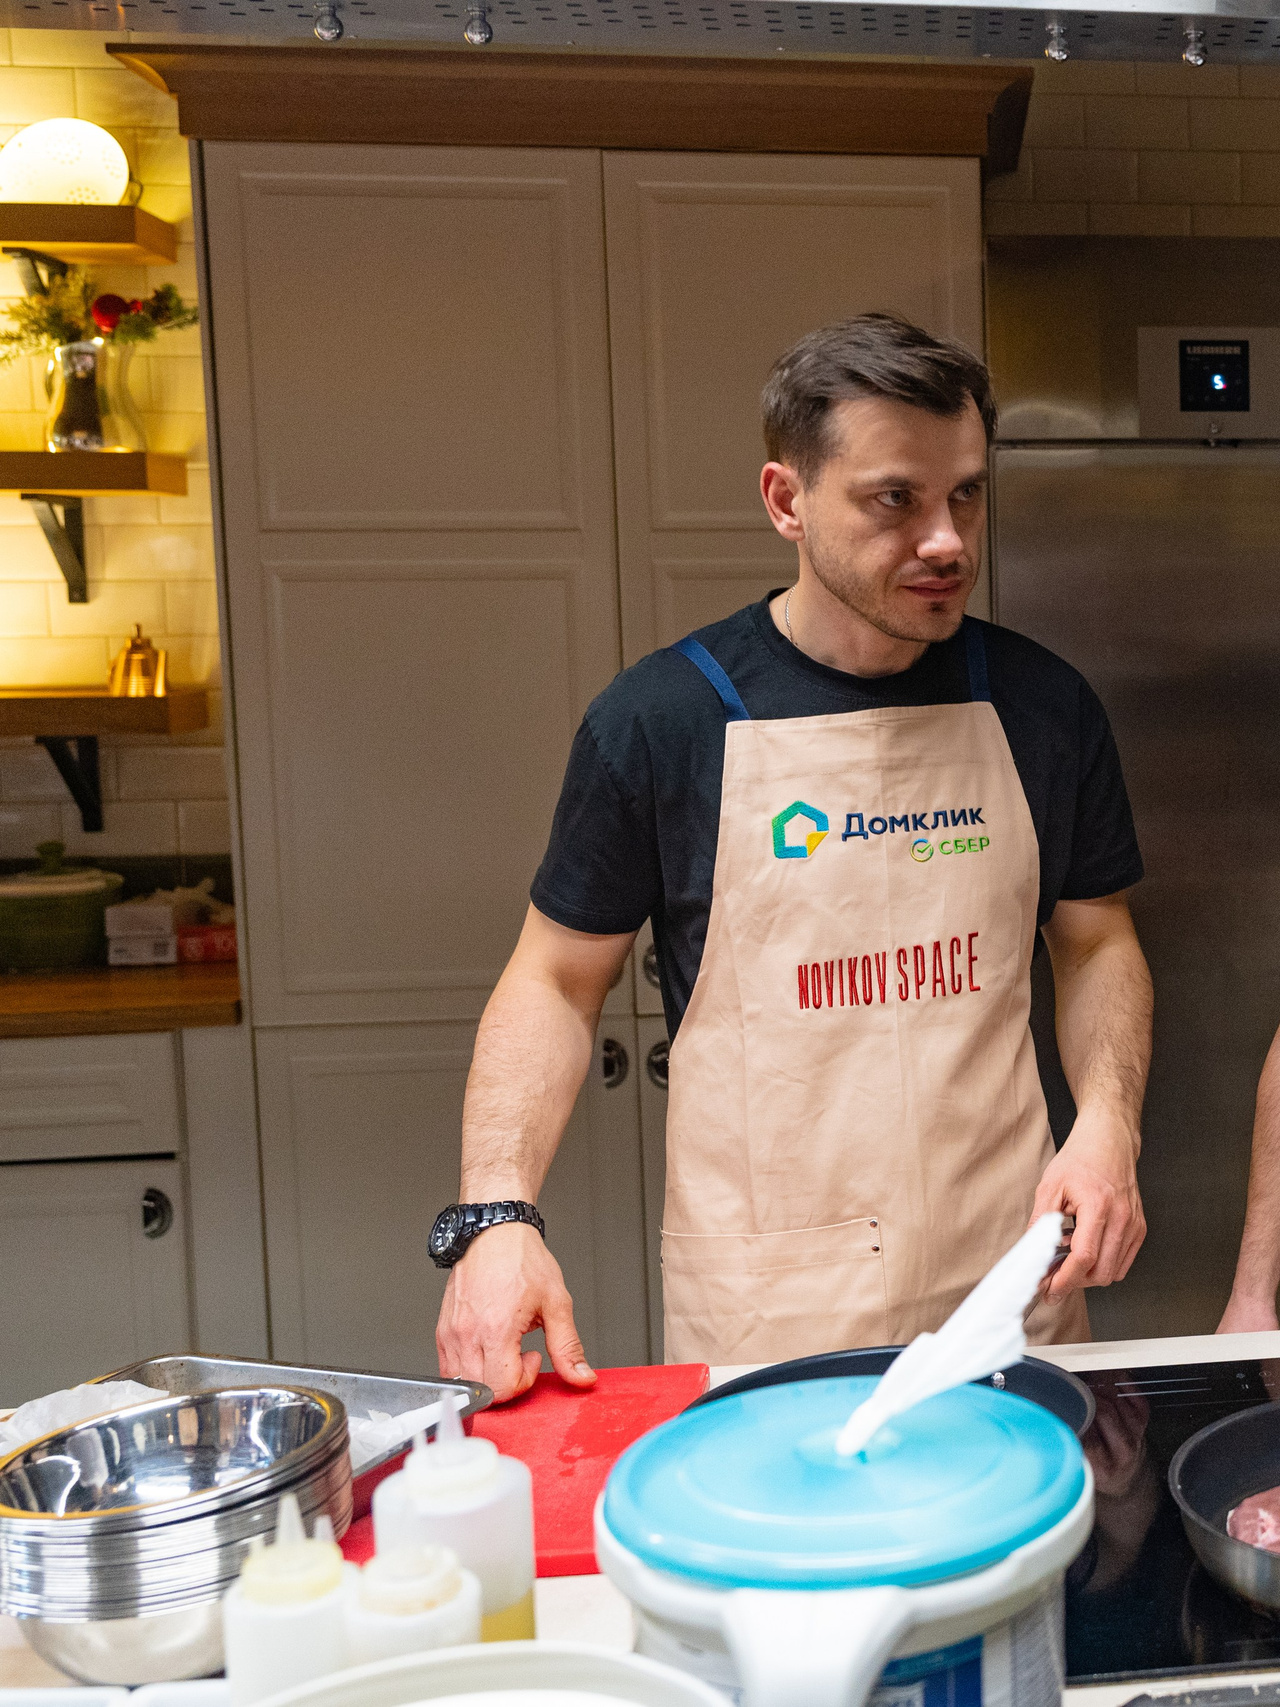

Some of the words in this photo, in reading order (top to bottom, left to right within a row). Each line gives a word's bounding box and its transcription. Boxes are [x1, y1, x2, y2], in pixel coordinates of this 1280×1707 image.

[841, 807, 986, 842] Домклик
[939, 836, 990, 855] СБЕР
[797, 951, 887, 1010] NOVIKOV
[896, 931, 981, 1002] SPACE
